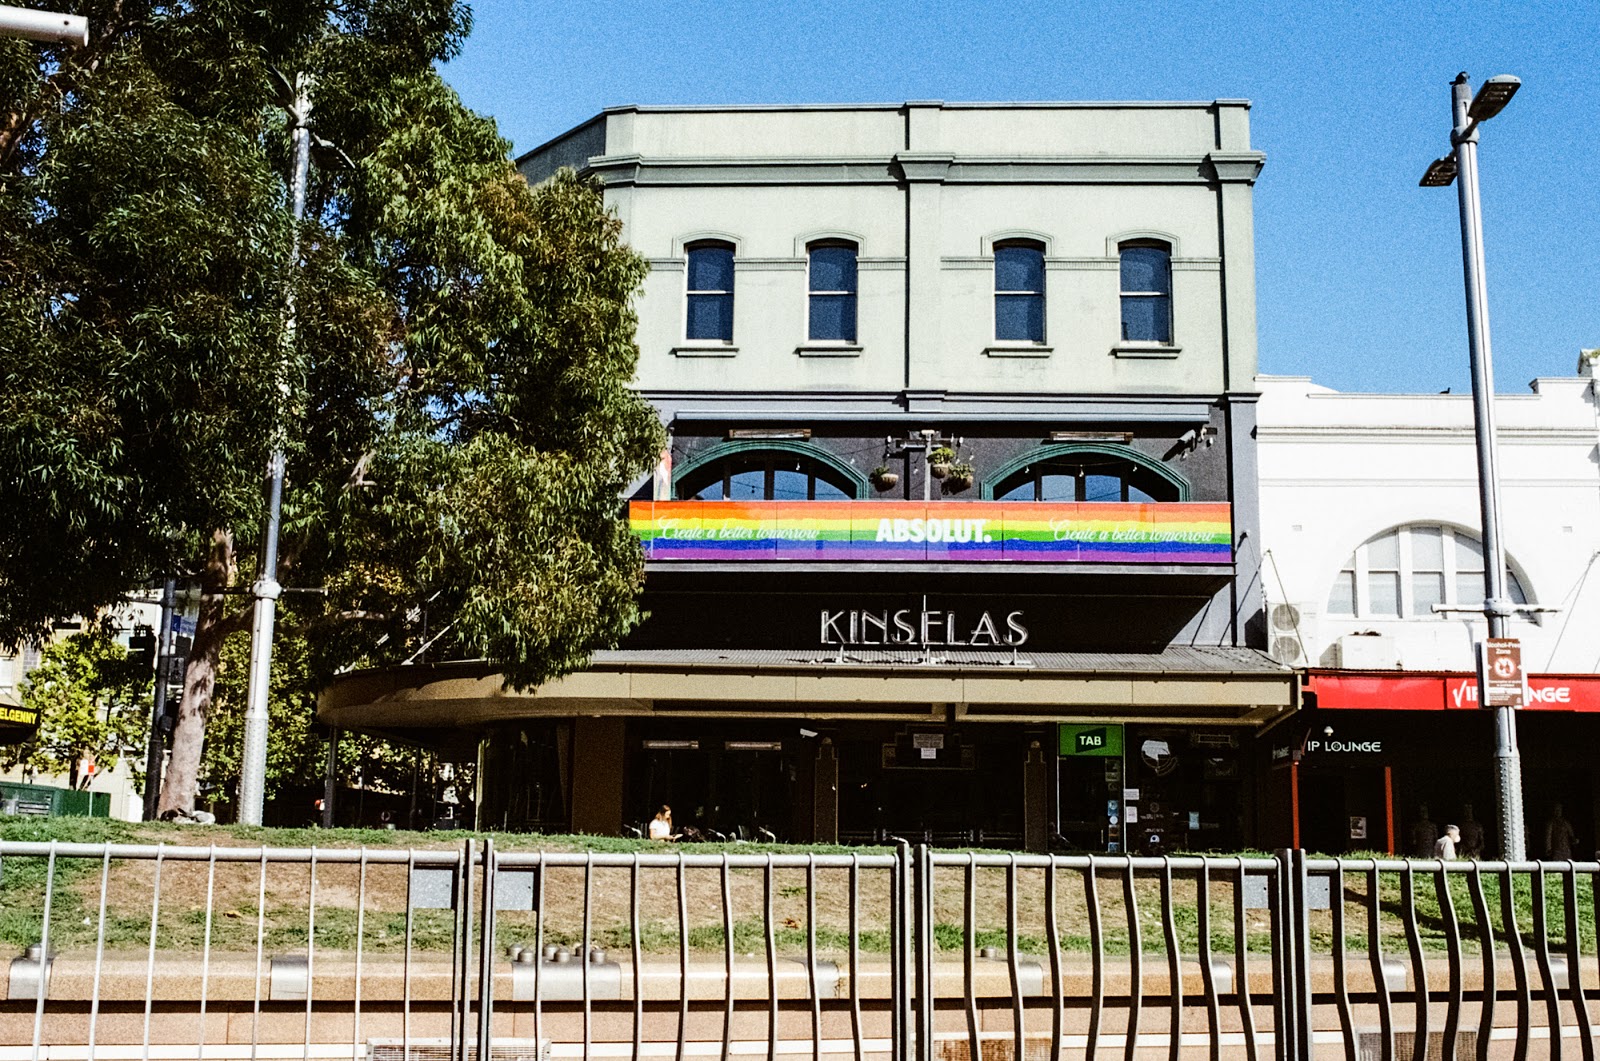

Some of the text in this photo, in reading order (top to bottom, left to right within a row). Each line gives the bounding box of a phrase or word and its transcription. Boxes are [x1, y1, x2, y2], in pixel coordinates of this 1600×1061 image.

[658, 515, 820, 540] Create a better tomorrow
[875, 518, 993, 543] ABSOLUT.
[1049, 517, 1216, 543] Create a better tomorrow
[820, 609, 1029, 646] KINSELAS
[1079, 735, 1102, 745] TAB
[1324, 740, 1382, 753] LOUNGE
